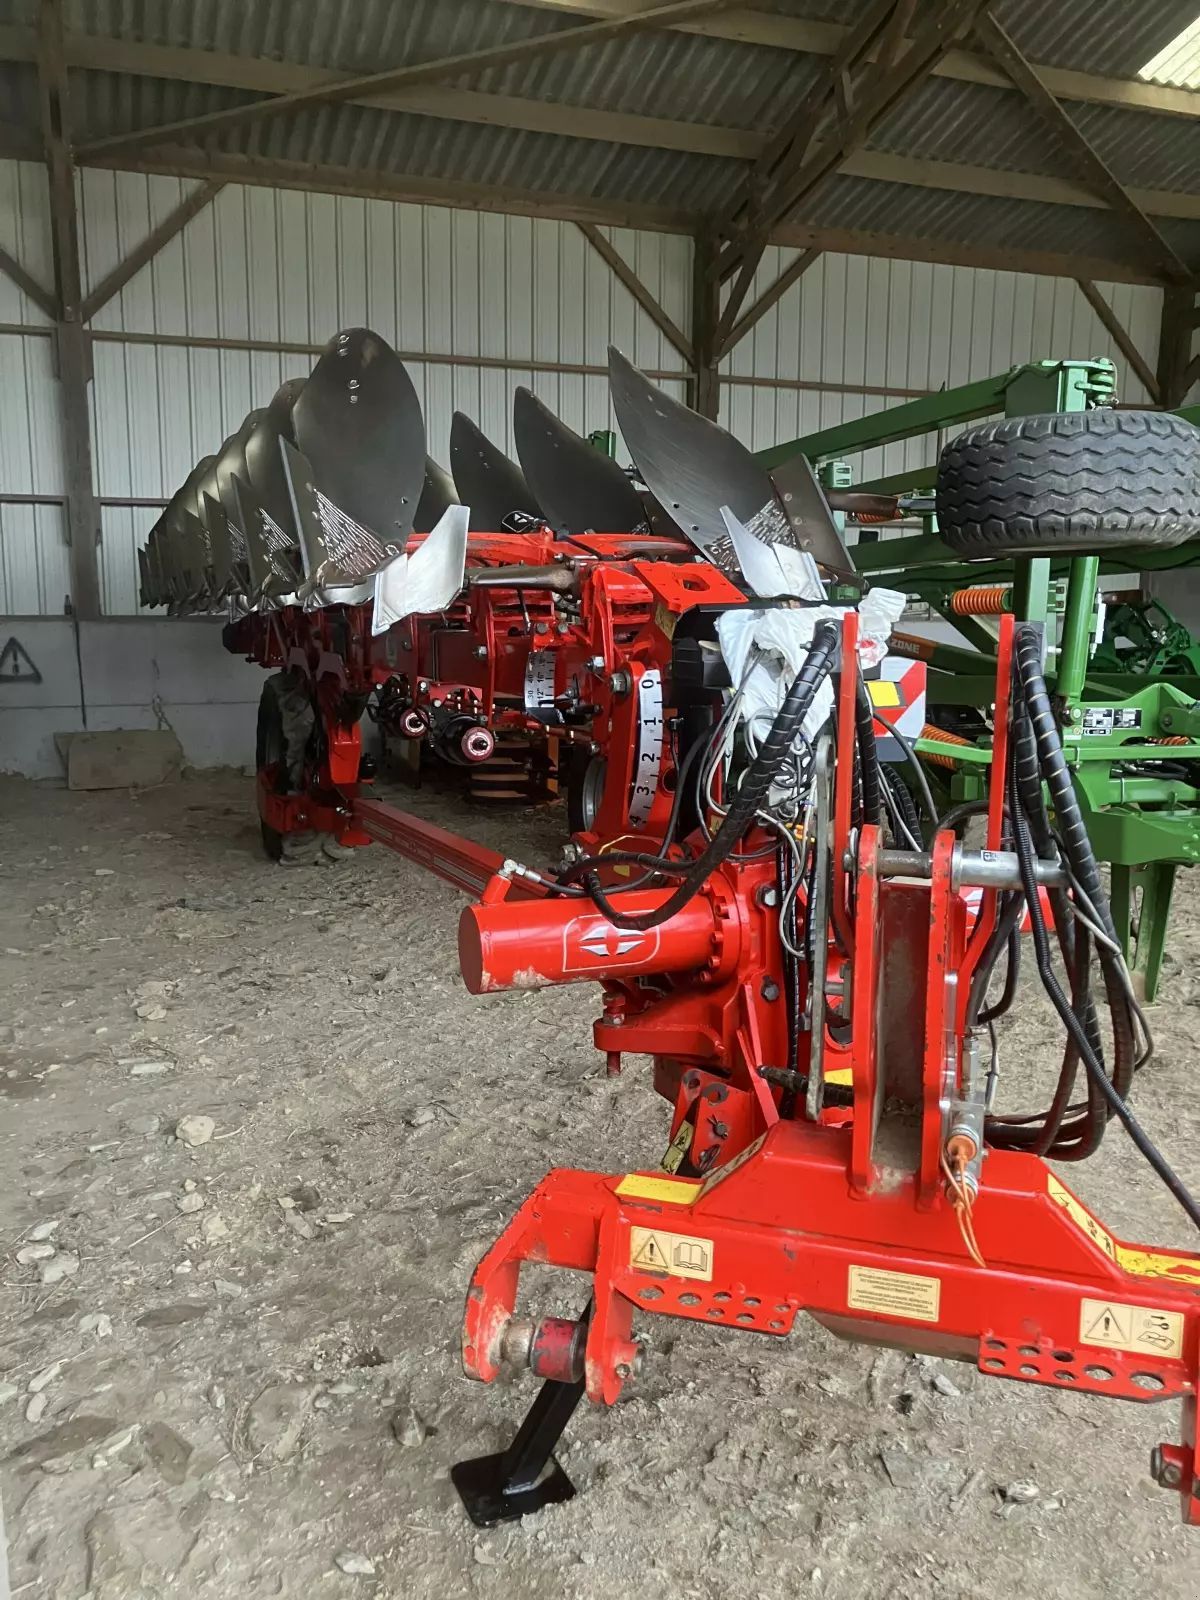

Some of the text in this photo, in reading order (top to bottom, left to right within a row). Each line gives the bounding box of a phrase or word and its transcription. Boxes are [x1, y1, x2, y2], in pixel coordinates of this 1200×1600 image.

[889, 638, 921, 655] ZONE
[641, 679, 654, 689] 0
[644, 717, 656, 726] 1
[641, 753, 655, 763] 2
[636, 785, 650, 796] 3
[629, 815, 642, 825] 4
